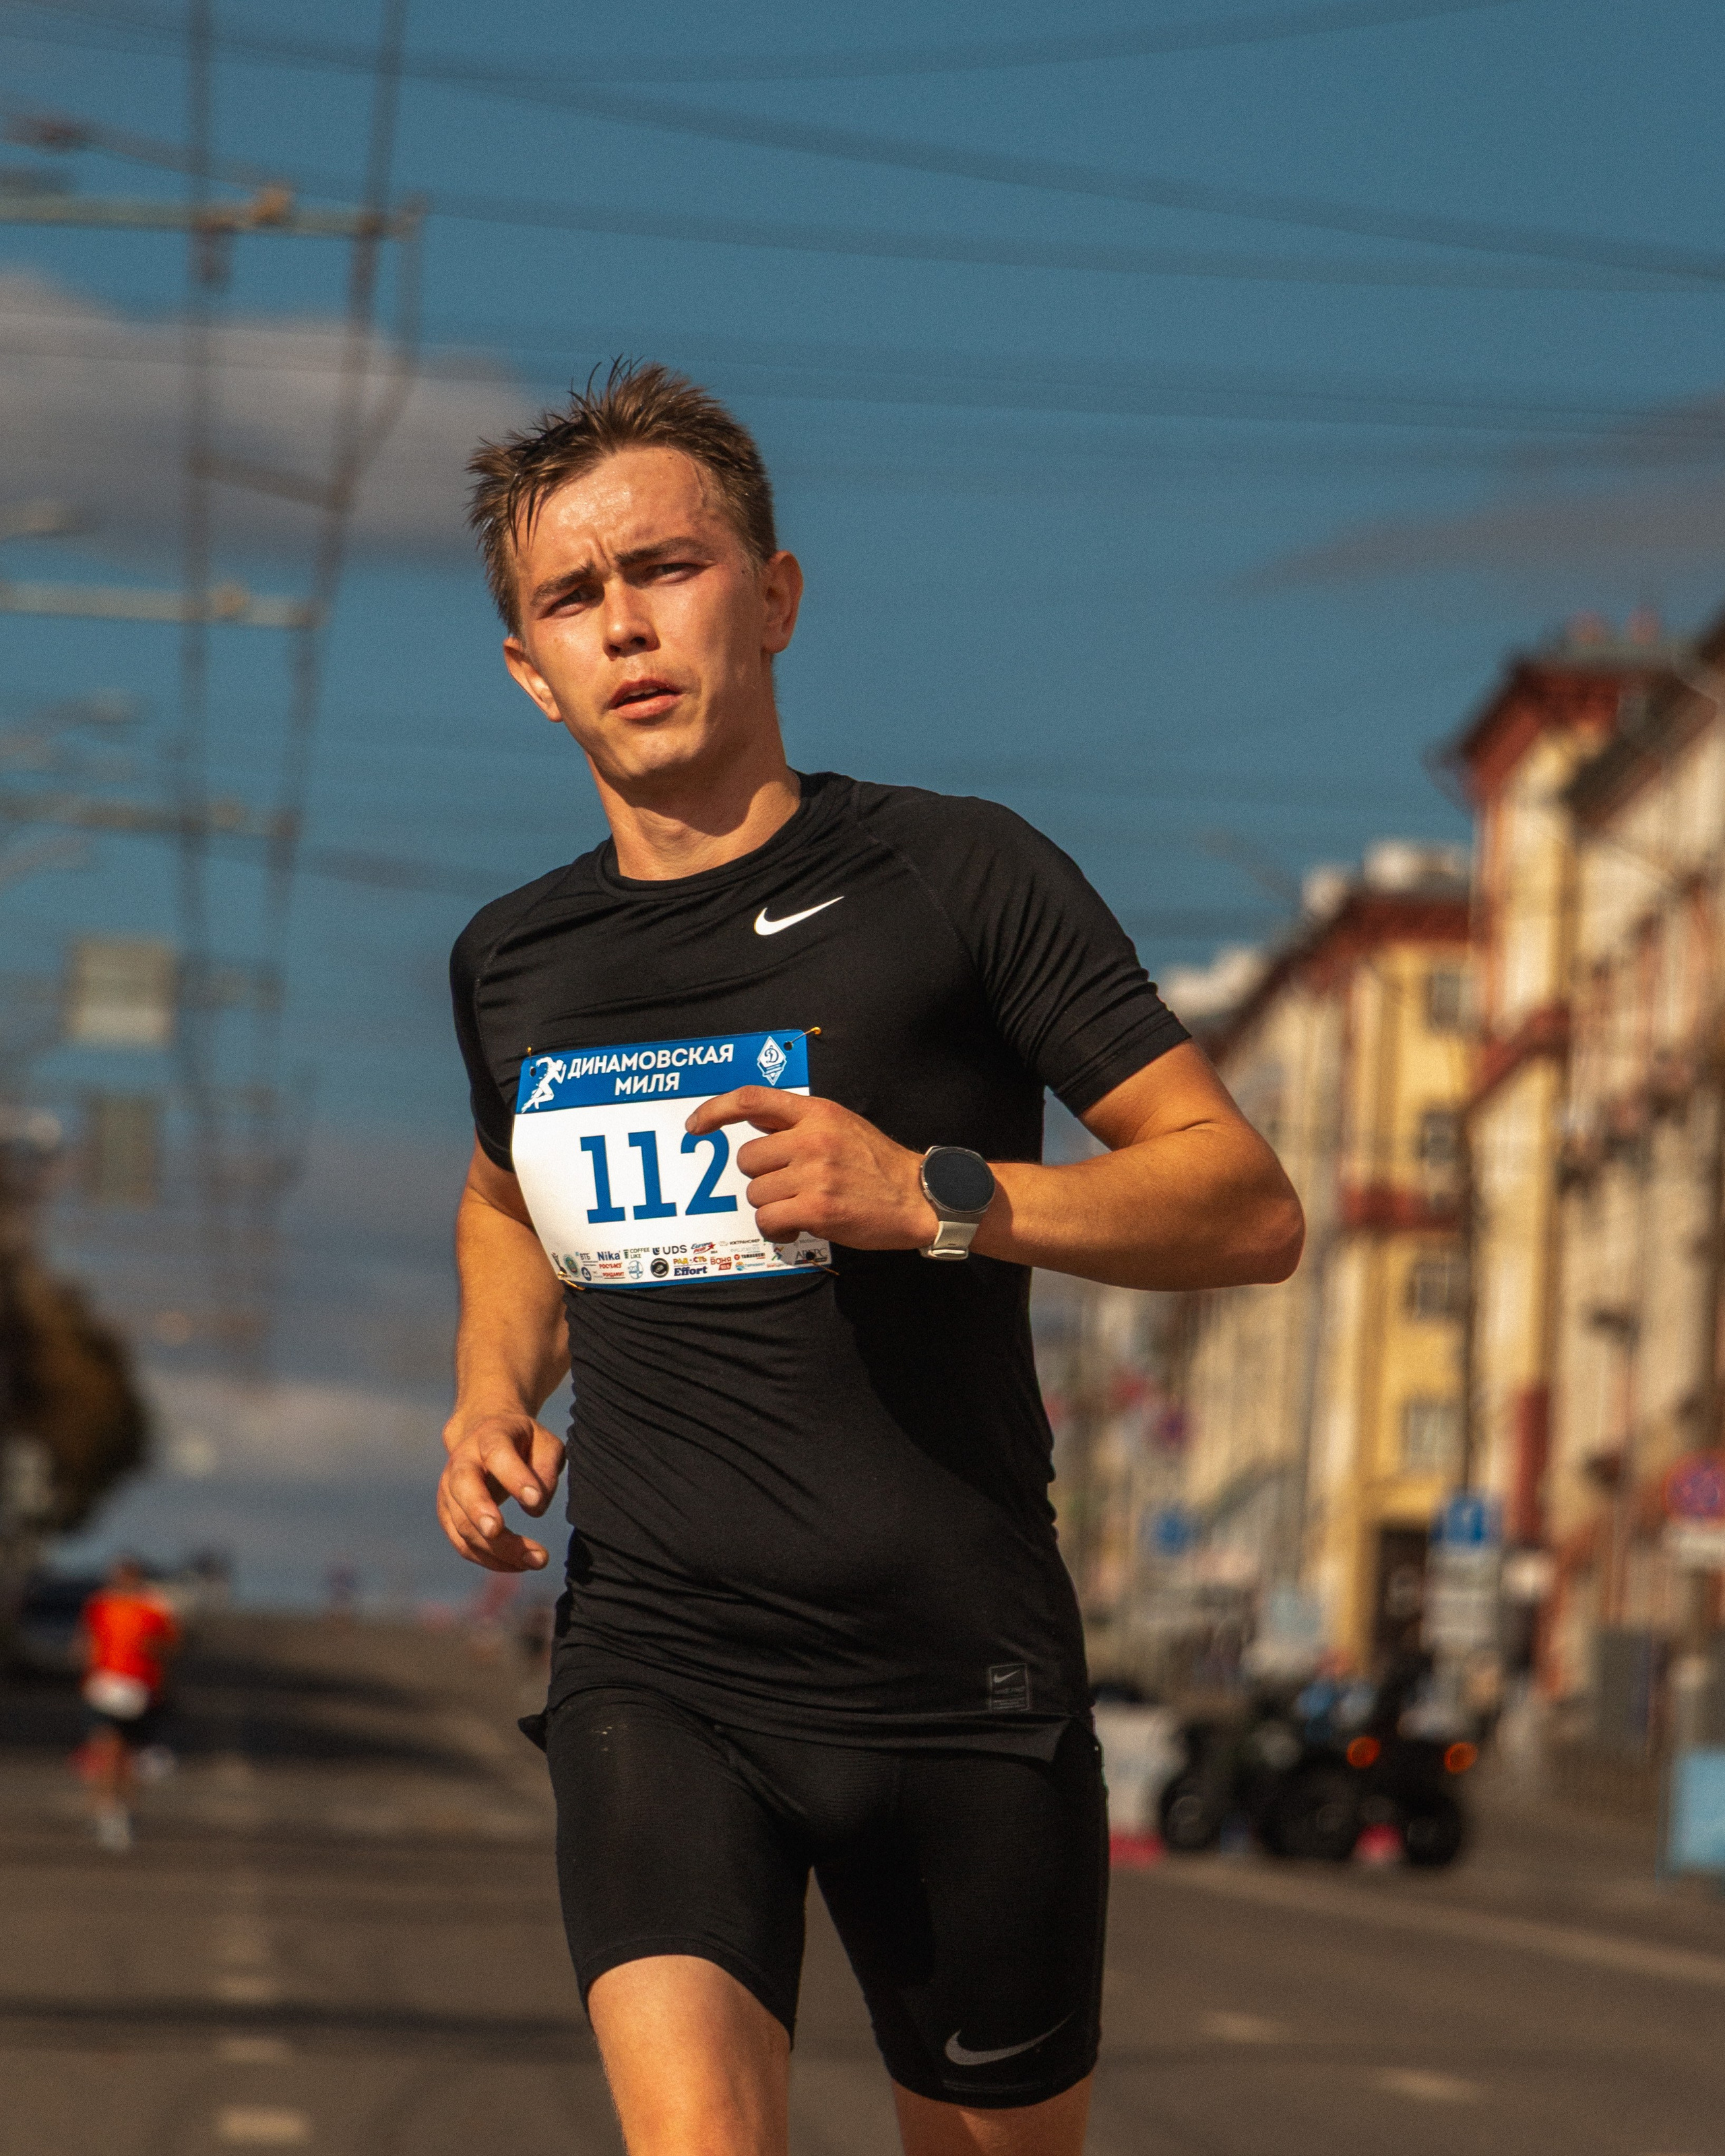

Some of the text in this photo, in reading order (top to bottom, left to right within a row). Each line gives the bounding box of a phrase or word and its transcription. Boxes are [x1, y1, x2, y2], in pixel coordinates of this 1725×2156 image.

[567, 1044, 734, 1079] ДИНАМОВСКАЯ
[615, 1072, 681, 1096] МИЛЯ
[580, 1129, 739, 1224] 112
[597, 1251, 621, 1261] Nika
[662, 1244, 687, 1255] UDS
[674, 1265, 708, 1276] Effort
